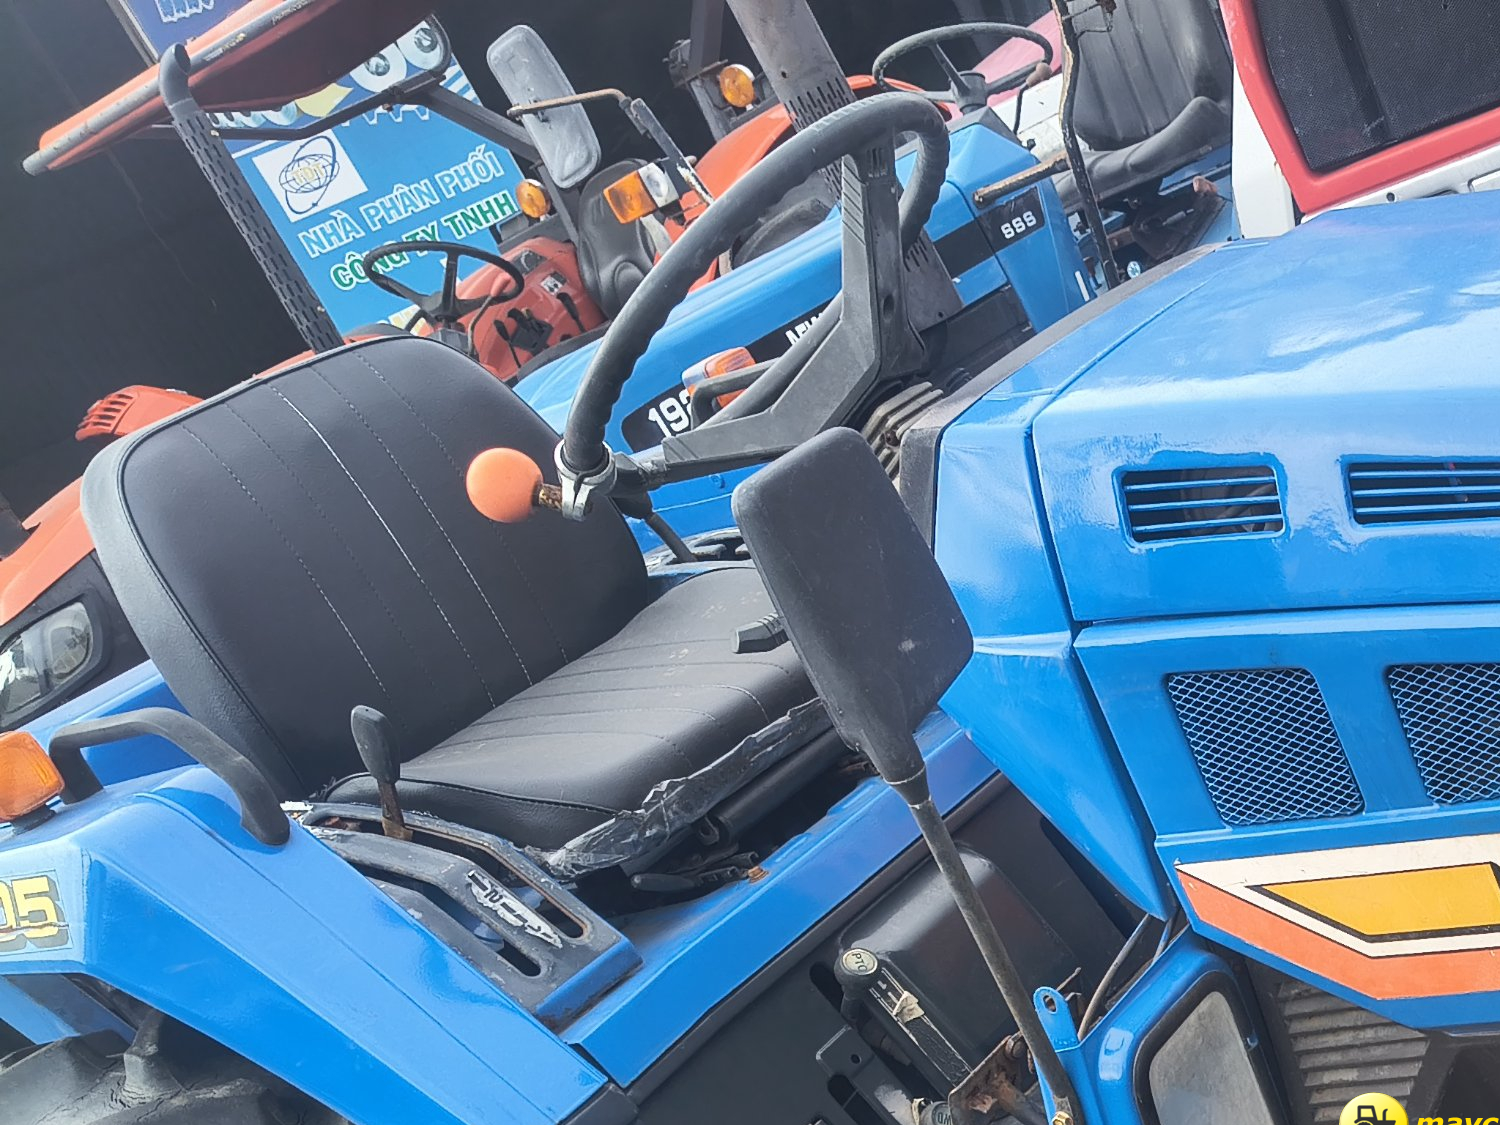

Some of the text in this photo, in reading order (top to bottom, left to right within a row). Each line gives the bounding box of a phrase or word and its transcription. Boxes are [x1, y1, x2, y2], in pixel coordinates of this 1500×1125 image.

[298, 144, 504, 258] NHÀ PHÂN PHỐI
[402, 224, 441, 257] TY
[443, 190, 519, 239] TNHH
[648, 388, 692, 438] 19
